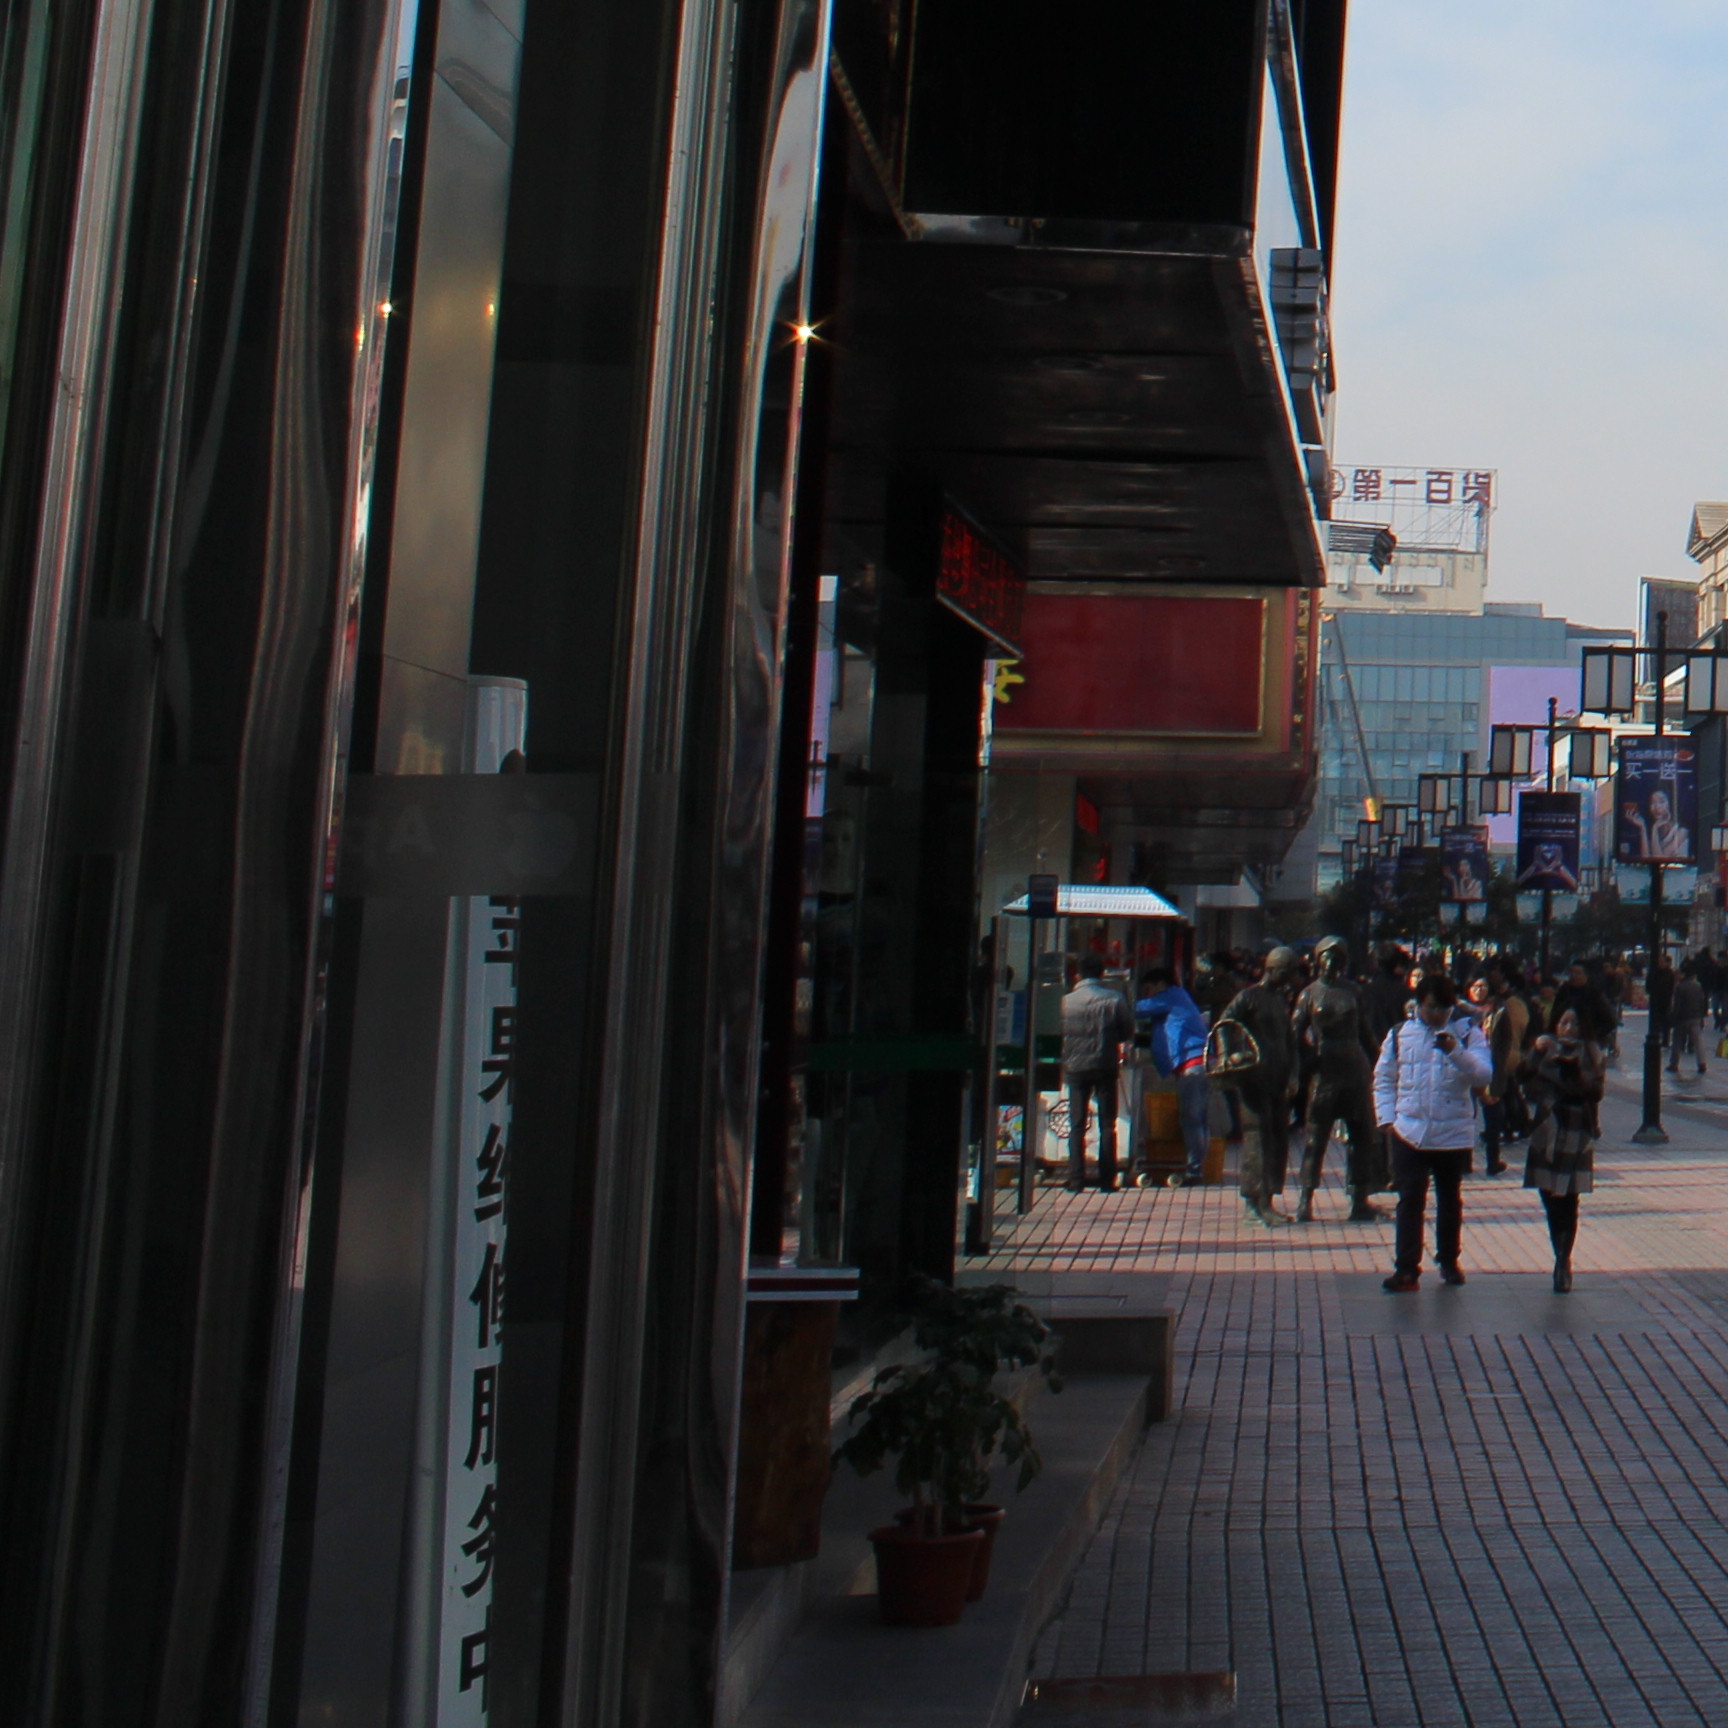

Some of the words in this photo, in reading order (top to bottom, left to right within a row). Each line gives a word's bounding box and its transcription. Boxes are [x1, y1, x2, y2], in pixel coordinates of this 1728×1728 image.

[1353, 469, 1491, 507] 第一百货
[1625, 761, 1693, 780] 买一送一
